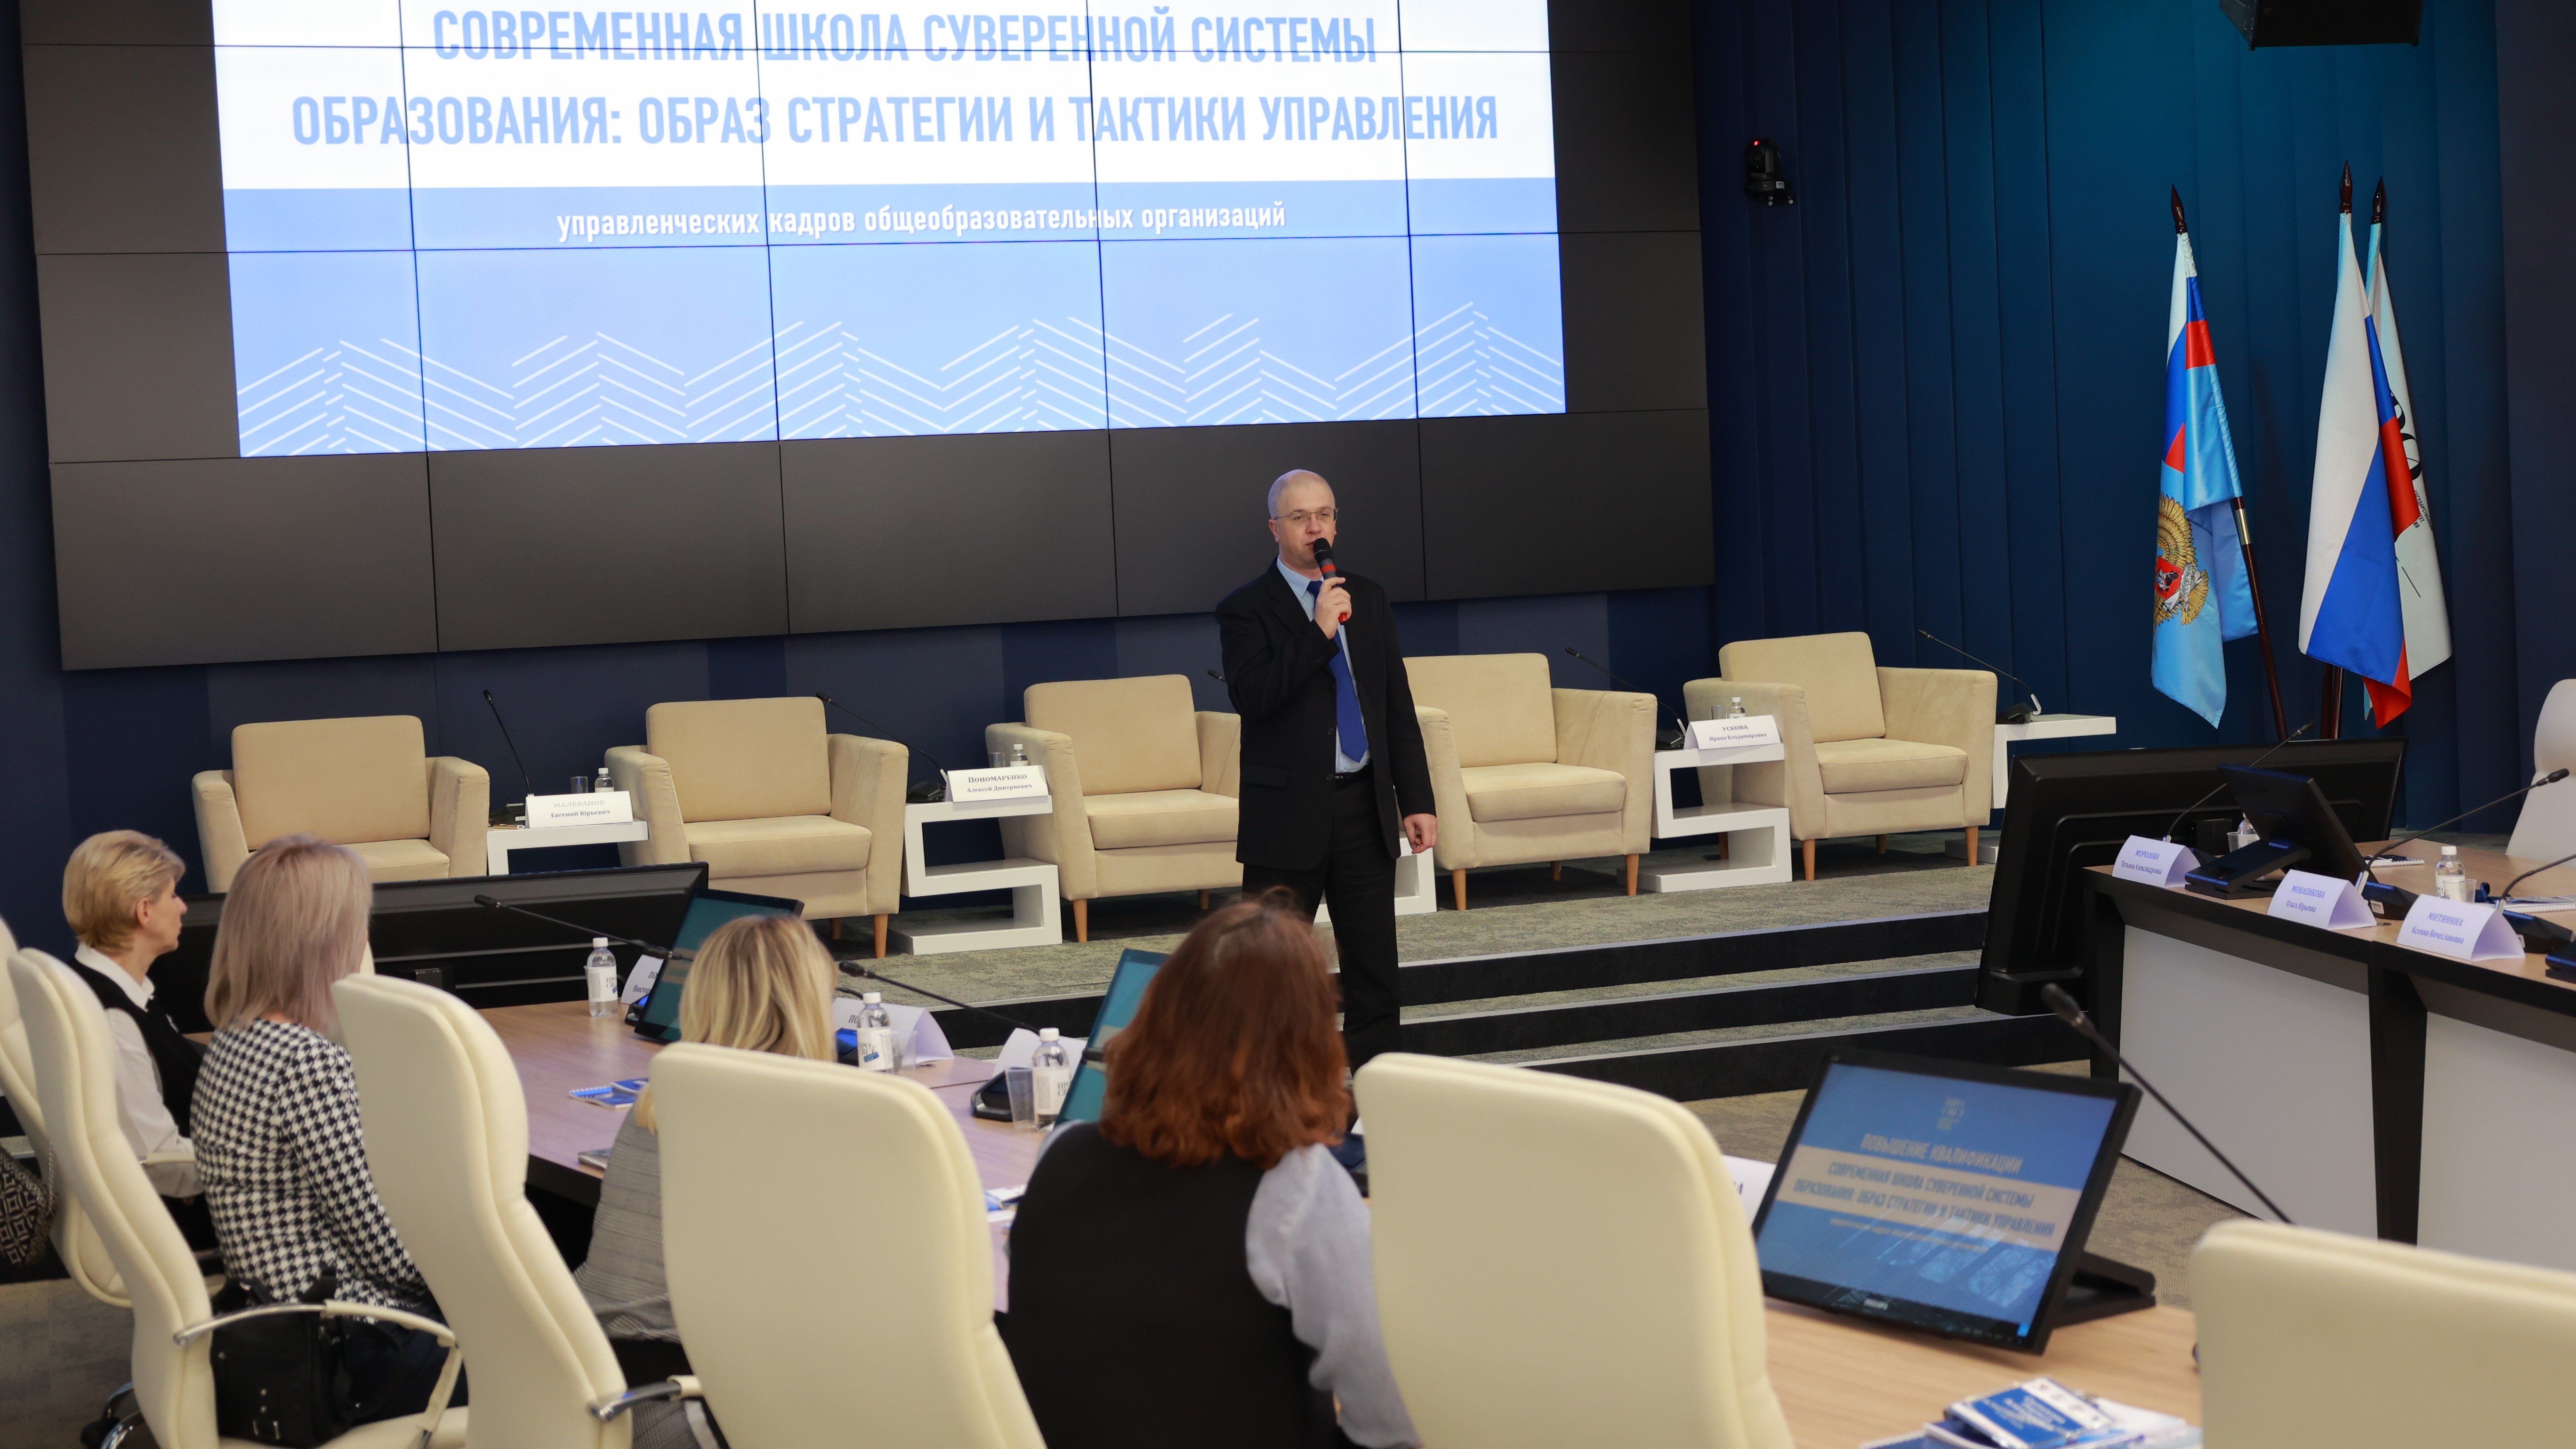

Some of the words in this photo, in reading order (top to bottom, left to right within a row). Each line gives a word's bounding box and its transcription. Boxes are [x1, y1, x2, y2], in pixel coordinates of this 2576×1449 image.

[434, 10, 743, 61] СОВРЕМЕННАЯ
[764, 13, 910, 62] ШКОЛА
[924, 7, 1175, 62] СУВЕРЕННОЙ
[1191, 16, 1376, 63] СИСТЕМЫ
[292, 96, 622, 145] ОБРАЗОВАНИЯ:
[638, 97, 771, 144] ОБРАЗ
[787, 97, 1013, 143] СТРАТЕГИИ
[1030, 96, 1056, 142] И
[1069, 96, 1247, 142] ТАКТИКИ
[1260, 95, 1497, 141] УПРАВЛЕНИЯ
[557, 210, 759, 242] управленческих
[769, 209, 855, 239] кадров
[864, 202, 1134, 237] общеобразовательных
[1142, 201, 1286, 234] организаций
[993, 783, 1032, 792] Дмитриевич
[554, 800, 605, 808] МАЛЕВАНОВ
[580, 810, 611, 818] Юрьевич
[2134, 850, 2160, 860] МОРОЗОВА
[2427, 912, 2463, 926] МИТЯНИНА
[2412, 926, 2429, 937] Ксения
[1930, 1145, 2023, 1174] КВАЛИФИКАЦИИ
